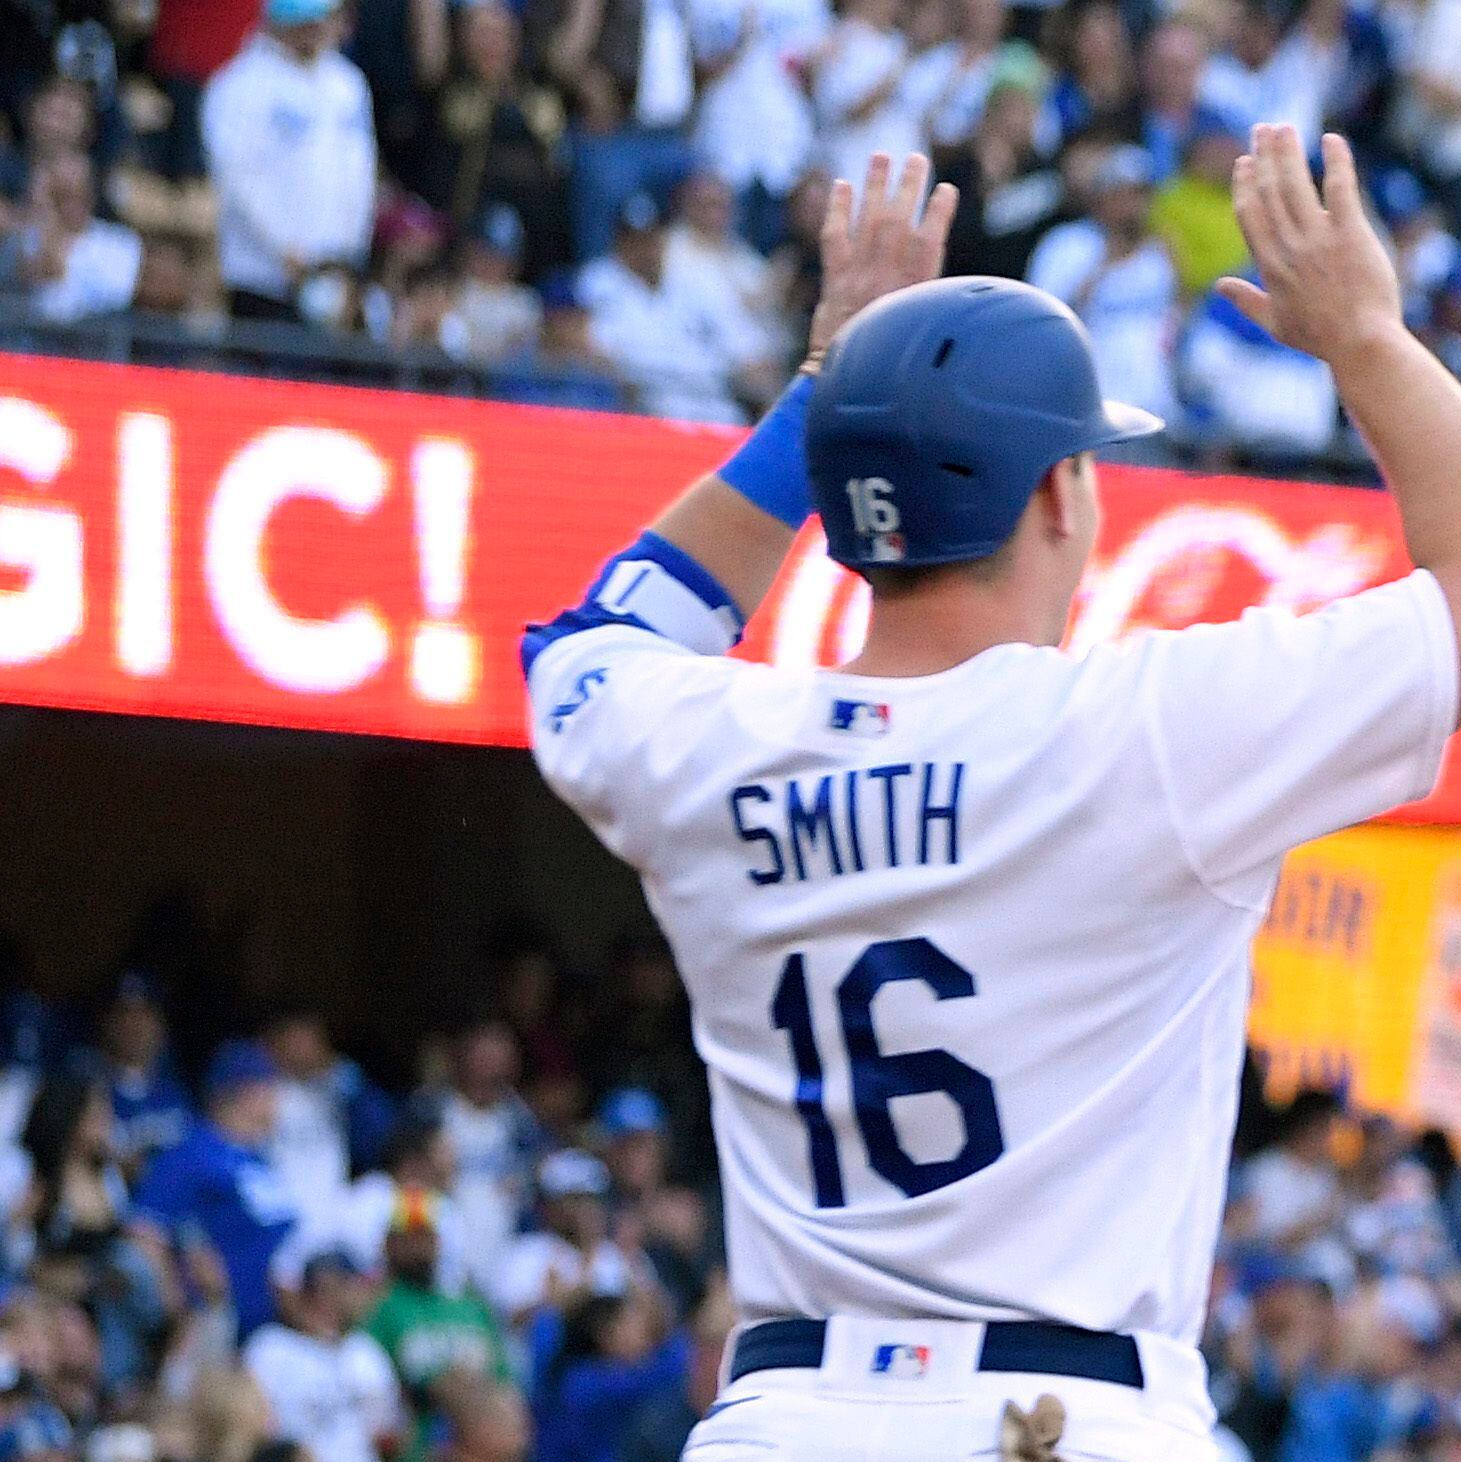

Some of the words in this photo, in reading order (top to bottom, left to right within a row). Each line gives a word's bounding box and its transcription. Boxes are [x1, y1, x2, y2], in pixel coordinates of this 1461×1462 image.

[846, 476, 900, 536] 16
[728, 762, 964, 886] SMITH
[771, 936, 1006, 1208] 16
